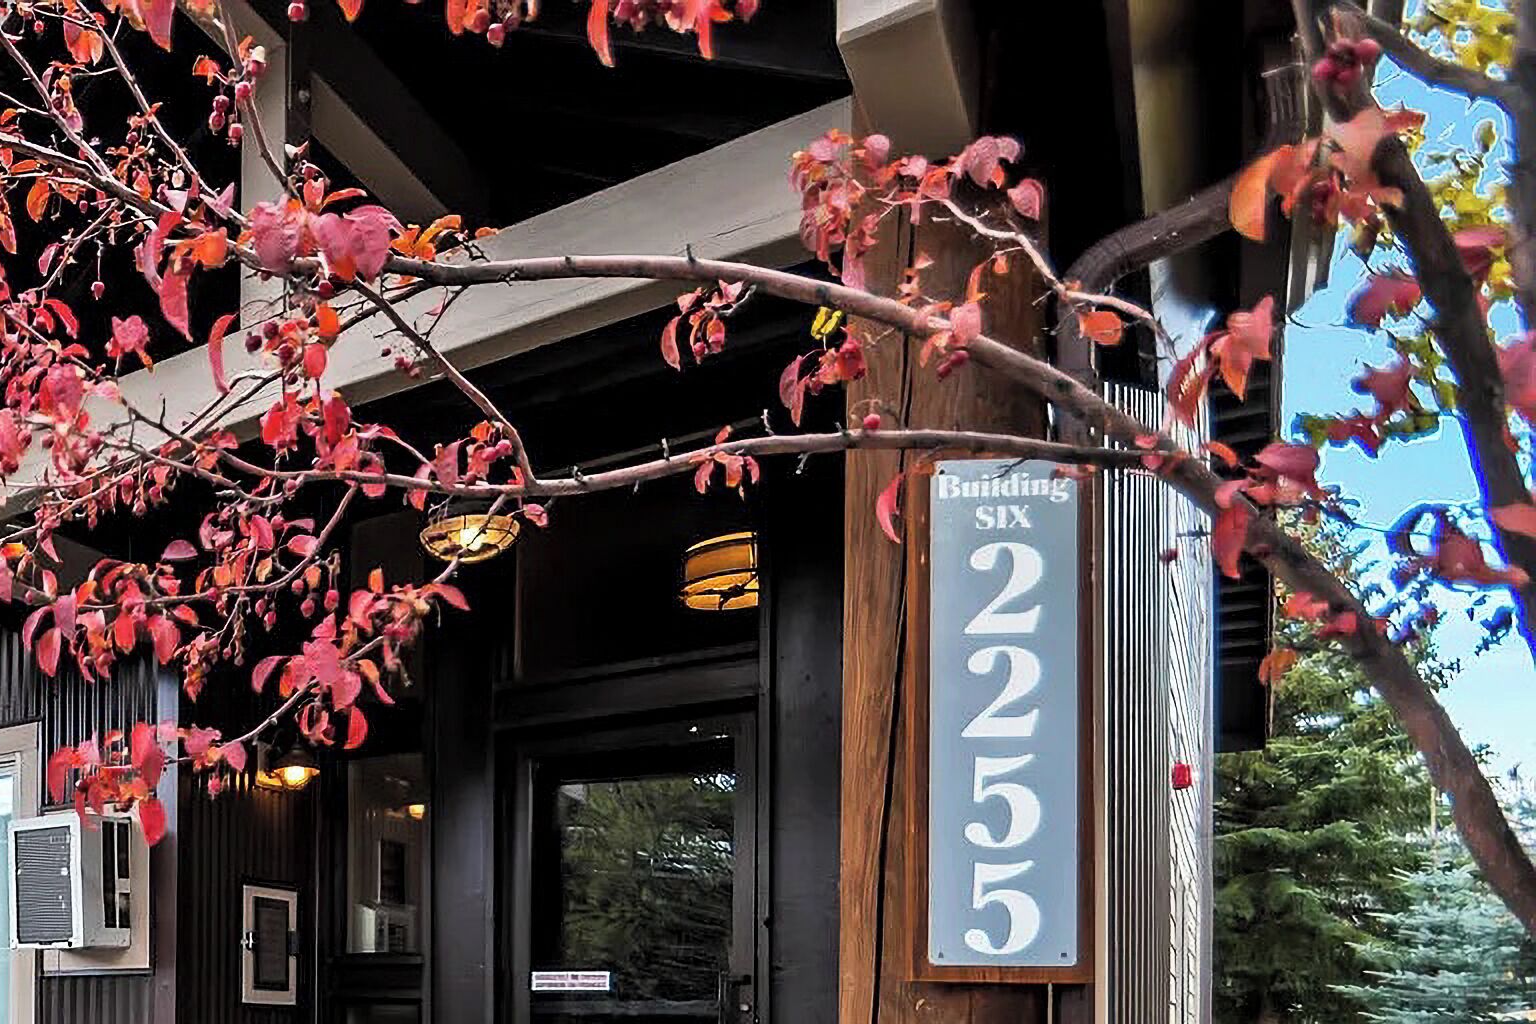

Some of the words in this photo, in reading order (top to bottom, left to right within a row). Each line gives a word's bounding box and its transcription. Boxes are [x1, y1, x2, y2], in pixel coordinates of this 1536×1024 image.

[938, 472, 1072, 502] Building
[975, 505, 1031, 529] SIX
[961, 541, 1043, 956] 2255
